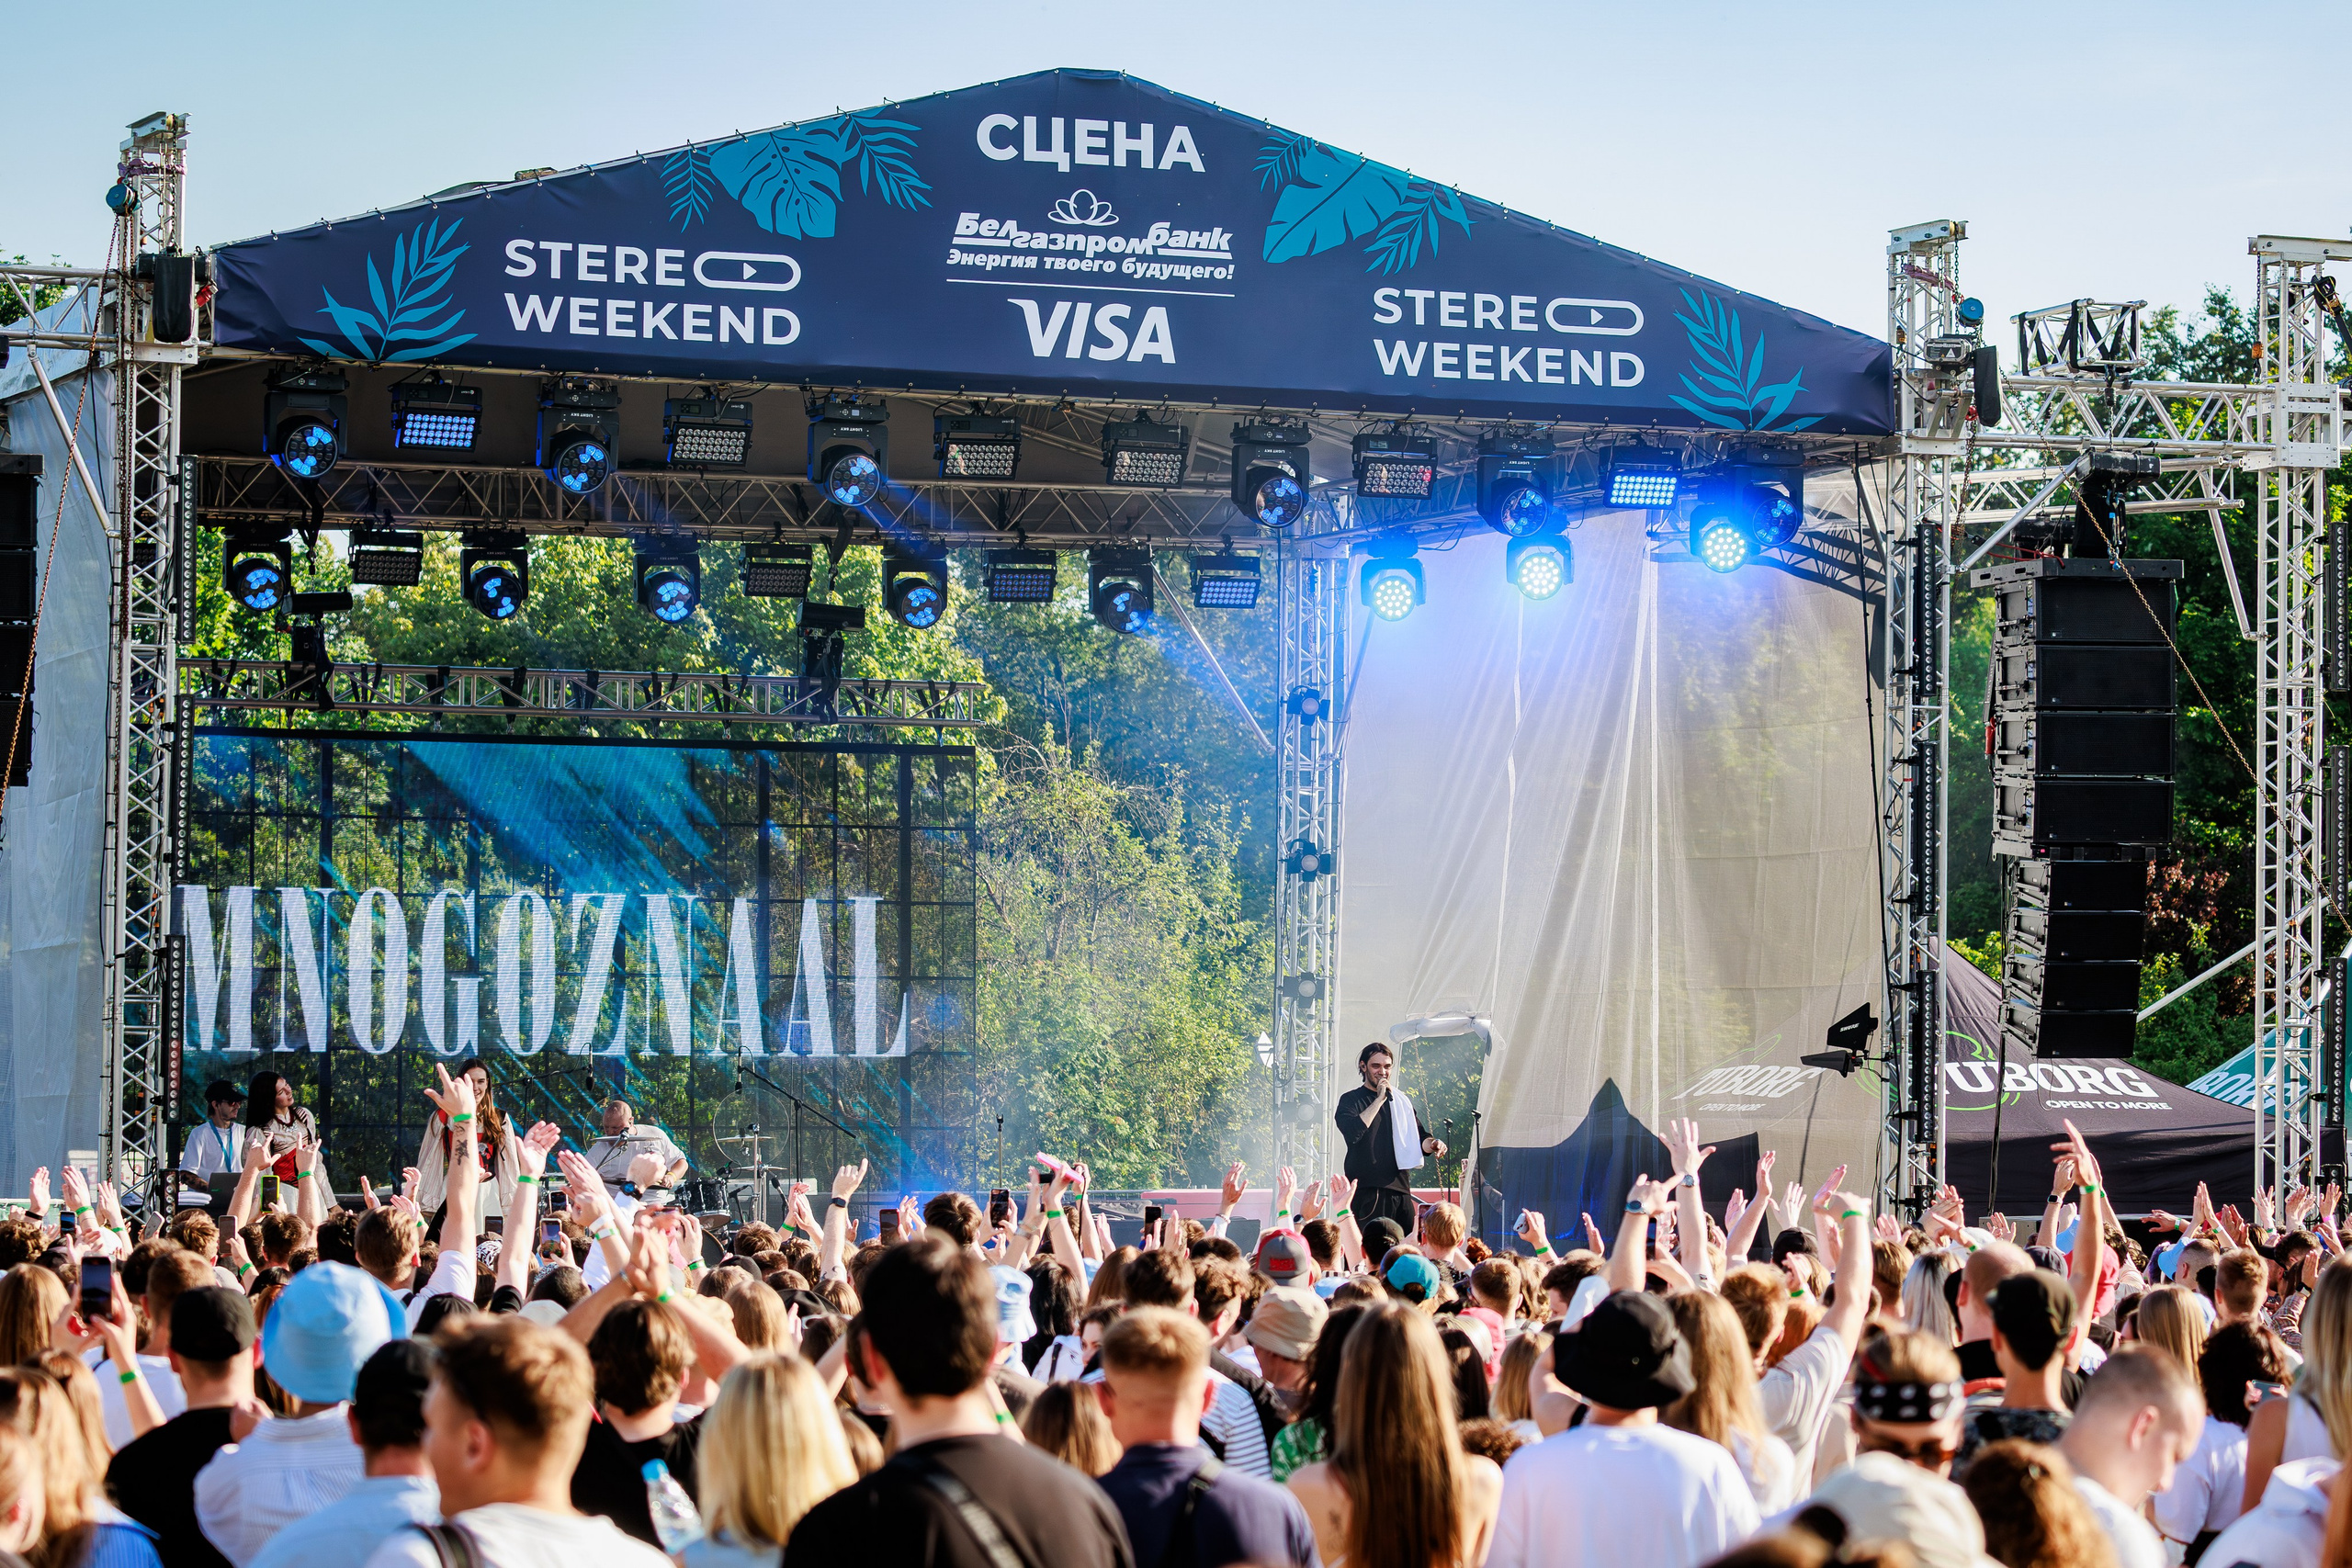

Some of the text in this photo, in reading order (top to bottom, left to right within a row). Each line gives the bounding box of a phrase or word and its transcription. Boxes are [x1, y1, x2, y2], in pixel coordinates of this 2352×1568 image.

[977, 113, 1206, 173] СЦЕНА
[954, 211, 1235, 258] Белгазпромбанк
[946, 248, 1236, 281] Энергия твоего будущего!
[504, 292, 802, 345] WEEKEND
[1007, 298, 1177, 364] VISA
[1373, 338, 1645, 388] WEEKEND
[179, 885, 909, 1058] MNOGOZNAAL
[1670, 1064, 1827, 1100] TUBORG
[2045, 1100, 2174, 1111] OPEN TO MORE
